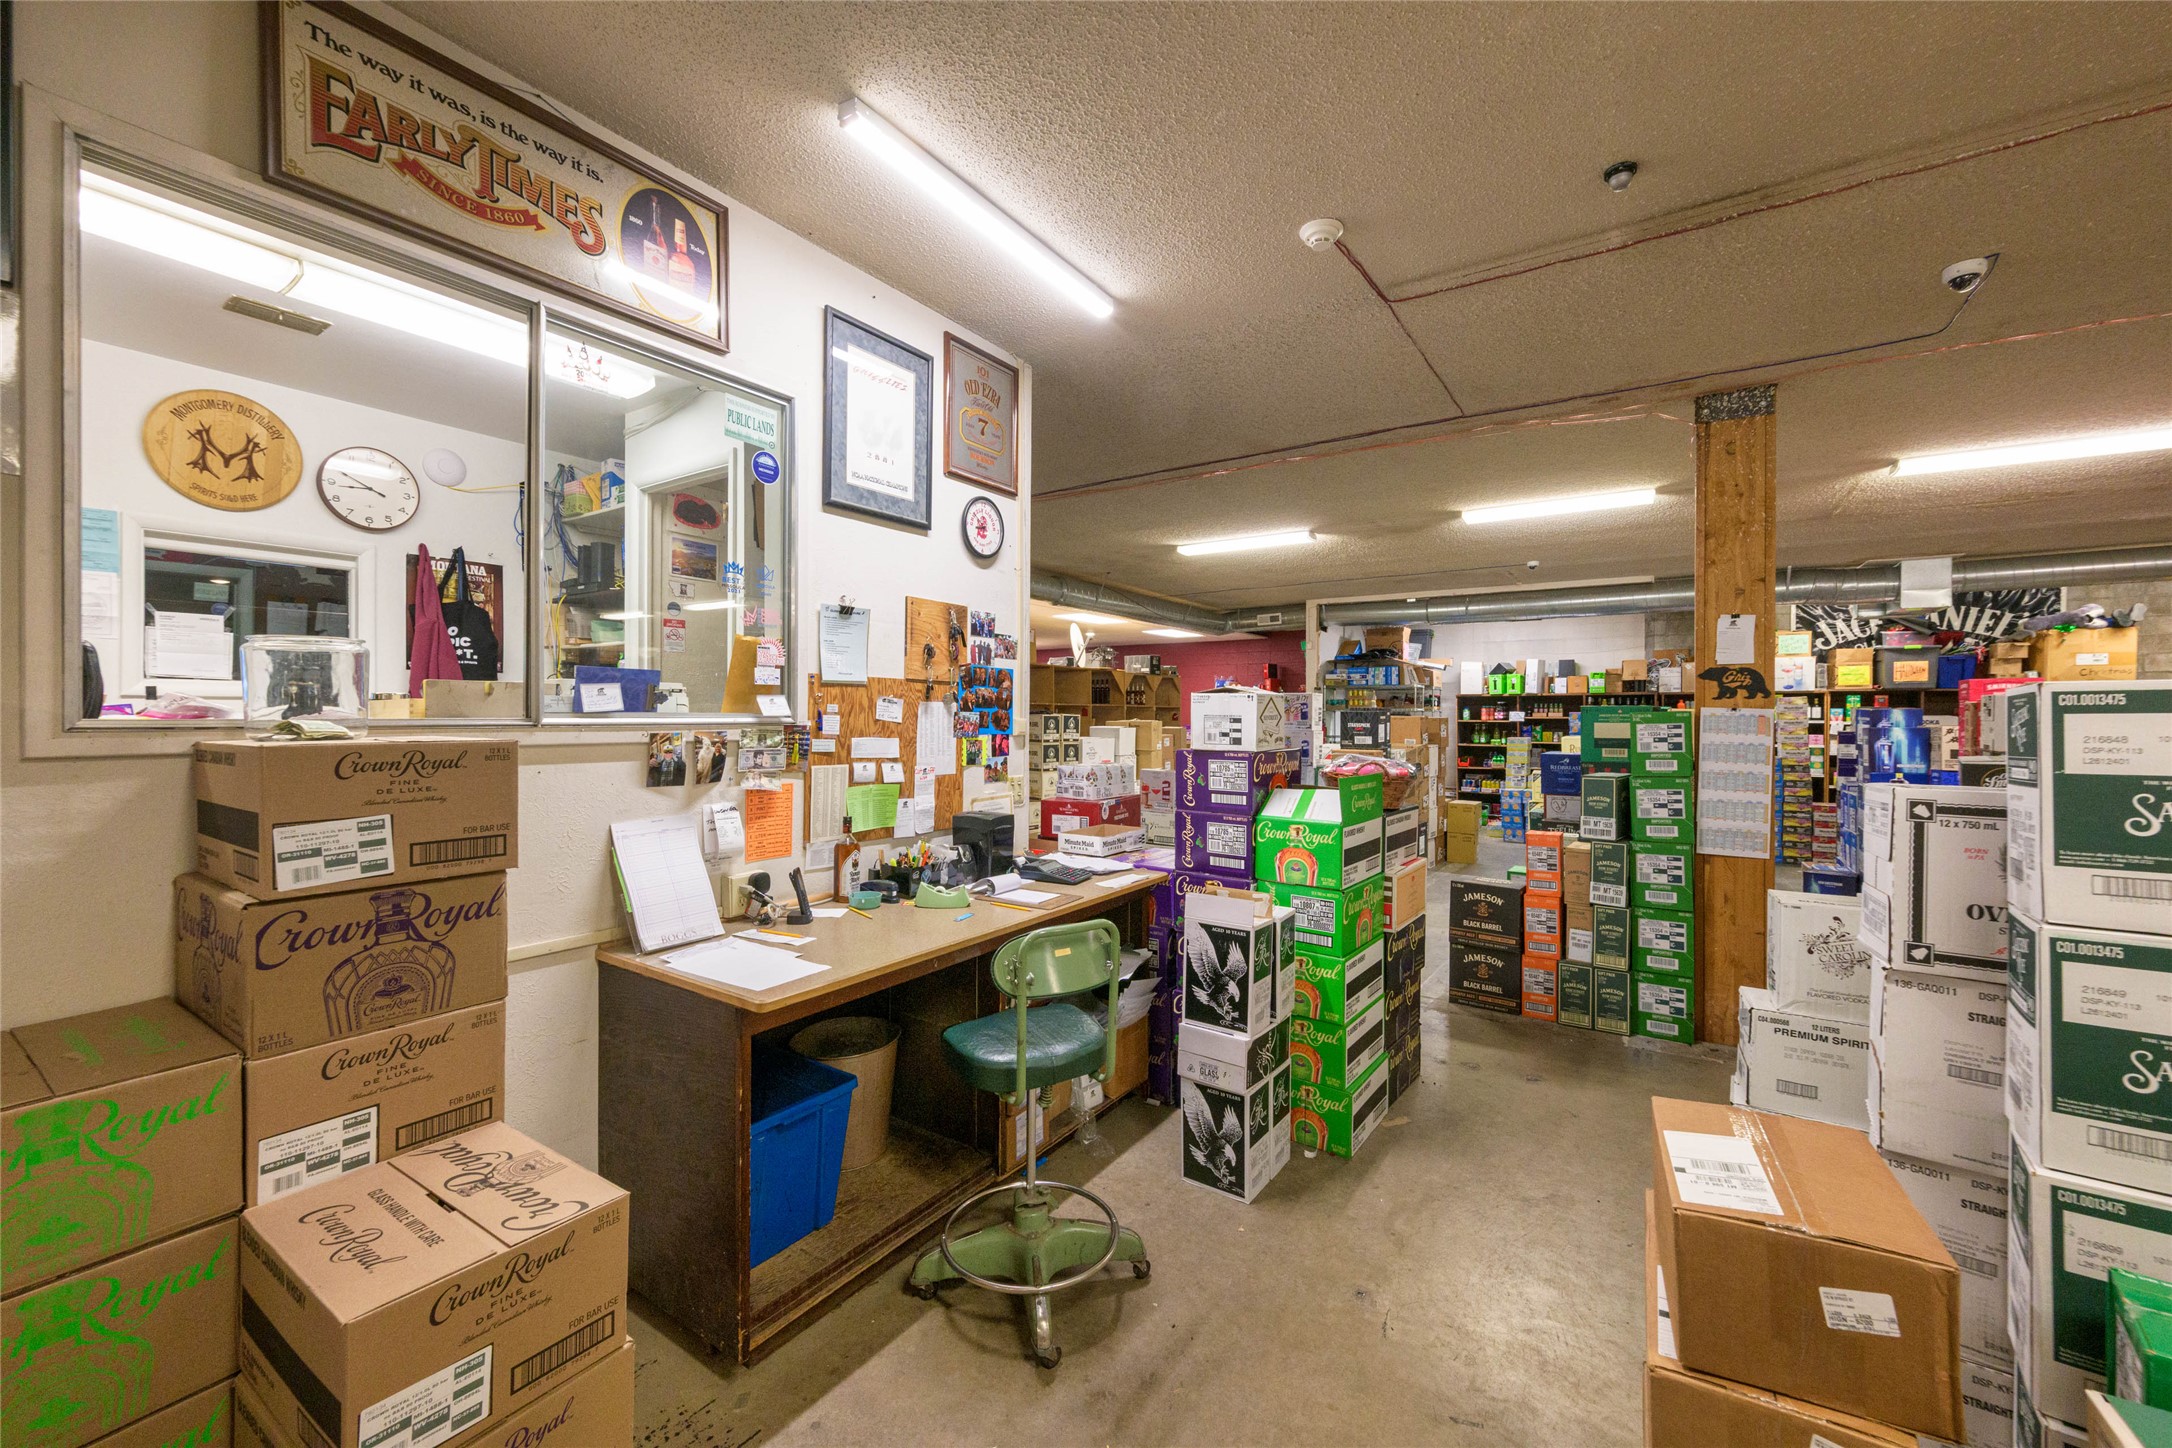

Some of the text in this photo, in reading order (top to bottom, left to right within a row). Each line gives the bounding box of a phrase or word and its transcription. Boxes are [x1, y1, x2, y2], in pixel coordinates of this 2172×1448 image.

[304, 20, 604, 183] The way it was, is the way it is.
[305, 53, 606, 256] EARLY TIMES
[417, 169, 525, 224] SINCE 1860
[853, 365, 909, 392] GRIZZLIES
[977, 365, 989, 378] 101
[964, 380, 980, 397] OLD
[169, 398, 285, 441] MONTGOMERY DISTILLERY
[727, 408, 751, 430] PUBLIC
[752, 417, 775, 437] LANDS
[978, 417, 989, 436] 7
[399, 477, 406, 485] 2
[189, 482, 217, 500] SPIRITS
[403, 492, 411, 500] 3
[365, 516, 374, 524] 6
[385, 515, 393, 523] 5
[722, 576, 741, 584] BEST
[2058, 693, 2127, 706] C01.0013475
[334, 750, 468, 780] Crown Royal
[484, 754, 511, 762] BOTTLES
[400, 786, 433, 794] LUXE
[463, 823, 511, 834] FOR BAR USE
[1593, 820, 1601, 828] MT
[1938, 820, 1951, 828] 12
[1962, 820, 1981, 830] 750
[1983, 822, 2000, 830] mL
[1102, 837, 1127, 848] Minute Maid
[1603, 887, 1611, 895] MT
[1463, 892, 1504, 906] JAMESON
[255, 881, 508, 971] Crown Royal
[1463, 919, 1502, 932] BLACK BARREL
[1598, 925, 1624, 933] JAMESON
[1815, 943, 1855, 955] SWEET
[1819, 949, 1873, 963] CAROLIN
[2056, 941, 2125, 959] C01.0013475
[1463, 953, 1504, 969] JAMESON
[1463, 980, 1503, 994] BLACK BARREL
[1563, 982, 1588, 991] JAMESON
[1599, 988, 1625, 997] JAMESON
[1894, 979, 1957, 997] 136-GAQ011
[1806, 991, 1842, 1001] FLAVORED
[471, 1017, 498, 1029] BOTTLES
[1967, 1012, 2006, 1027] STRAIG
[1774, 1027, 1829, 1044] PREMIUM
[1819, 1026, 1840, 1034] LITERS
[257, 1037, 294, 1053] BOTTLES
[321, 1022, 454, 1081] Crown Royal
[376, 1062, 407, 1075] FINE
[1199, 1067, 1219, 1079] GLASS
[363, 1066, 421, 1087] DE LUXE
[449, 1085, 497, 1107] FOR BAR USE
[1206, 1088, 1220, 1096] AGED
[1226, 1092, 1241, 1101] YEARS
[1887, 1158, 1950, 1182] 136-GAQ011
[2057, 1189, 2127, 1216] C01.0013475
[367, 1188, 445, 1248] GLASS HANDLE WITH CARE
[593, 1216, 621, 1234] BOTTLES
[298, 1203, 408, 1274] Crown Royal
[429, 1230, 575, 1327] Crown Royal
[490, 1287, 523, 1309] FINE
[475, 1290, 539, 1326] DE LUXE
[568, 1295, 620, 1330] FOR BAR USE
